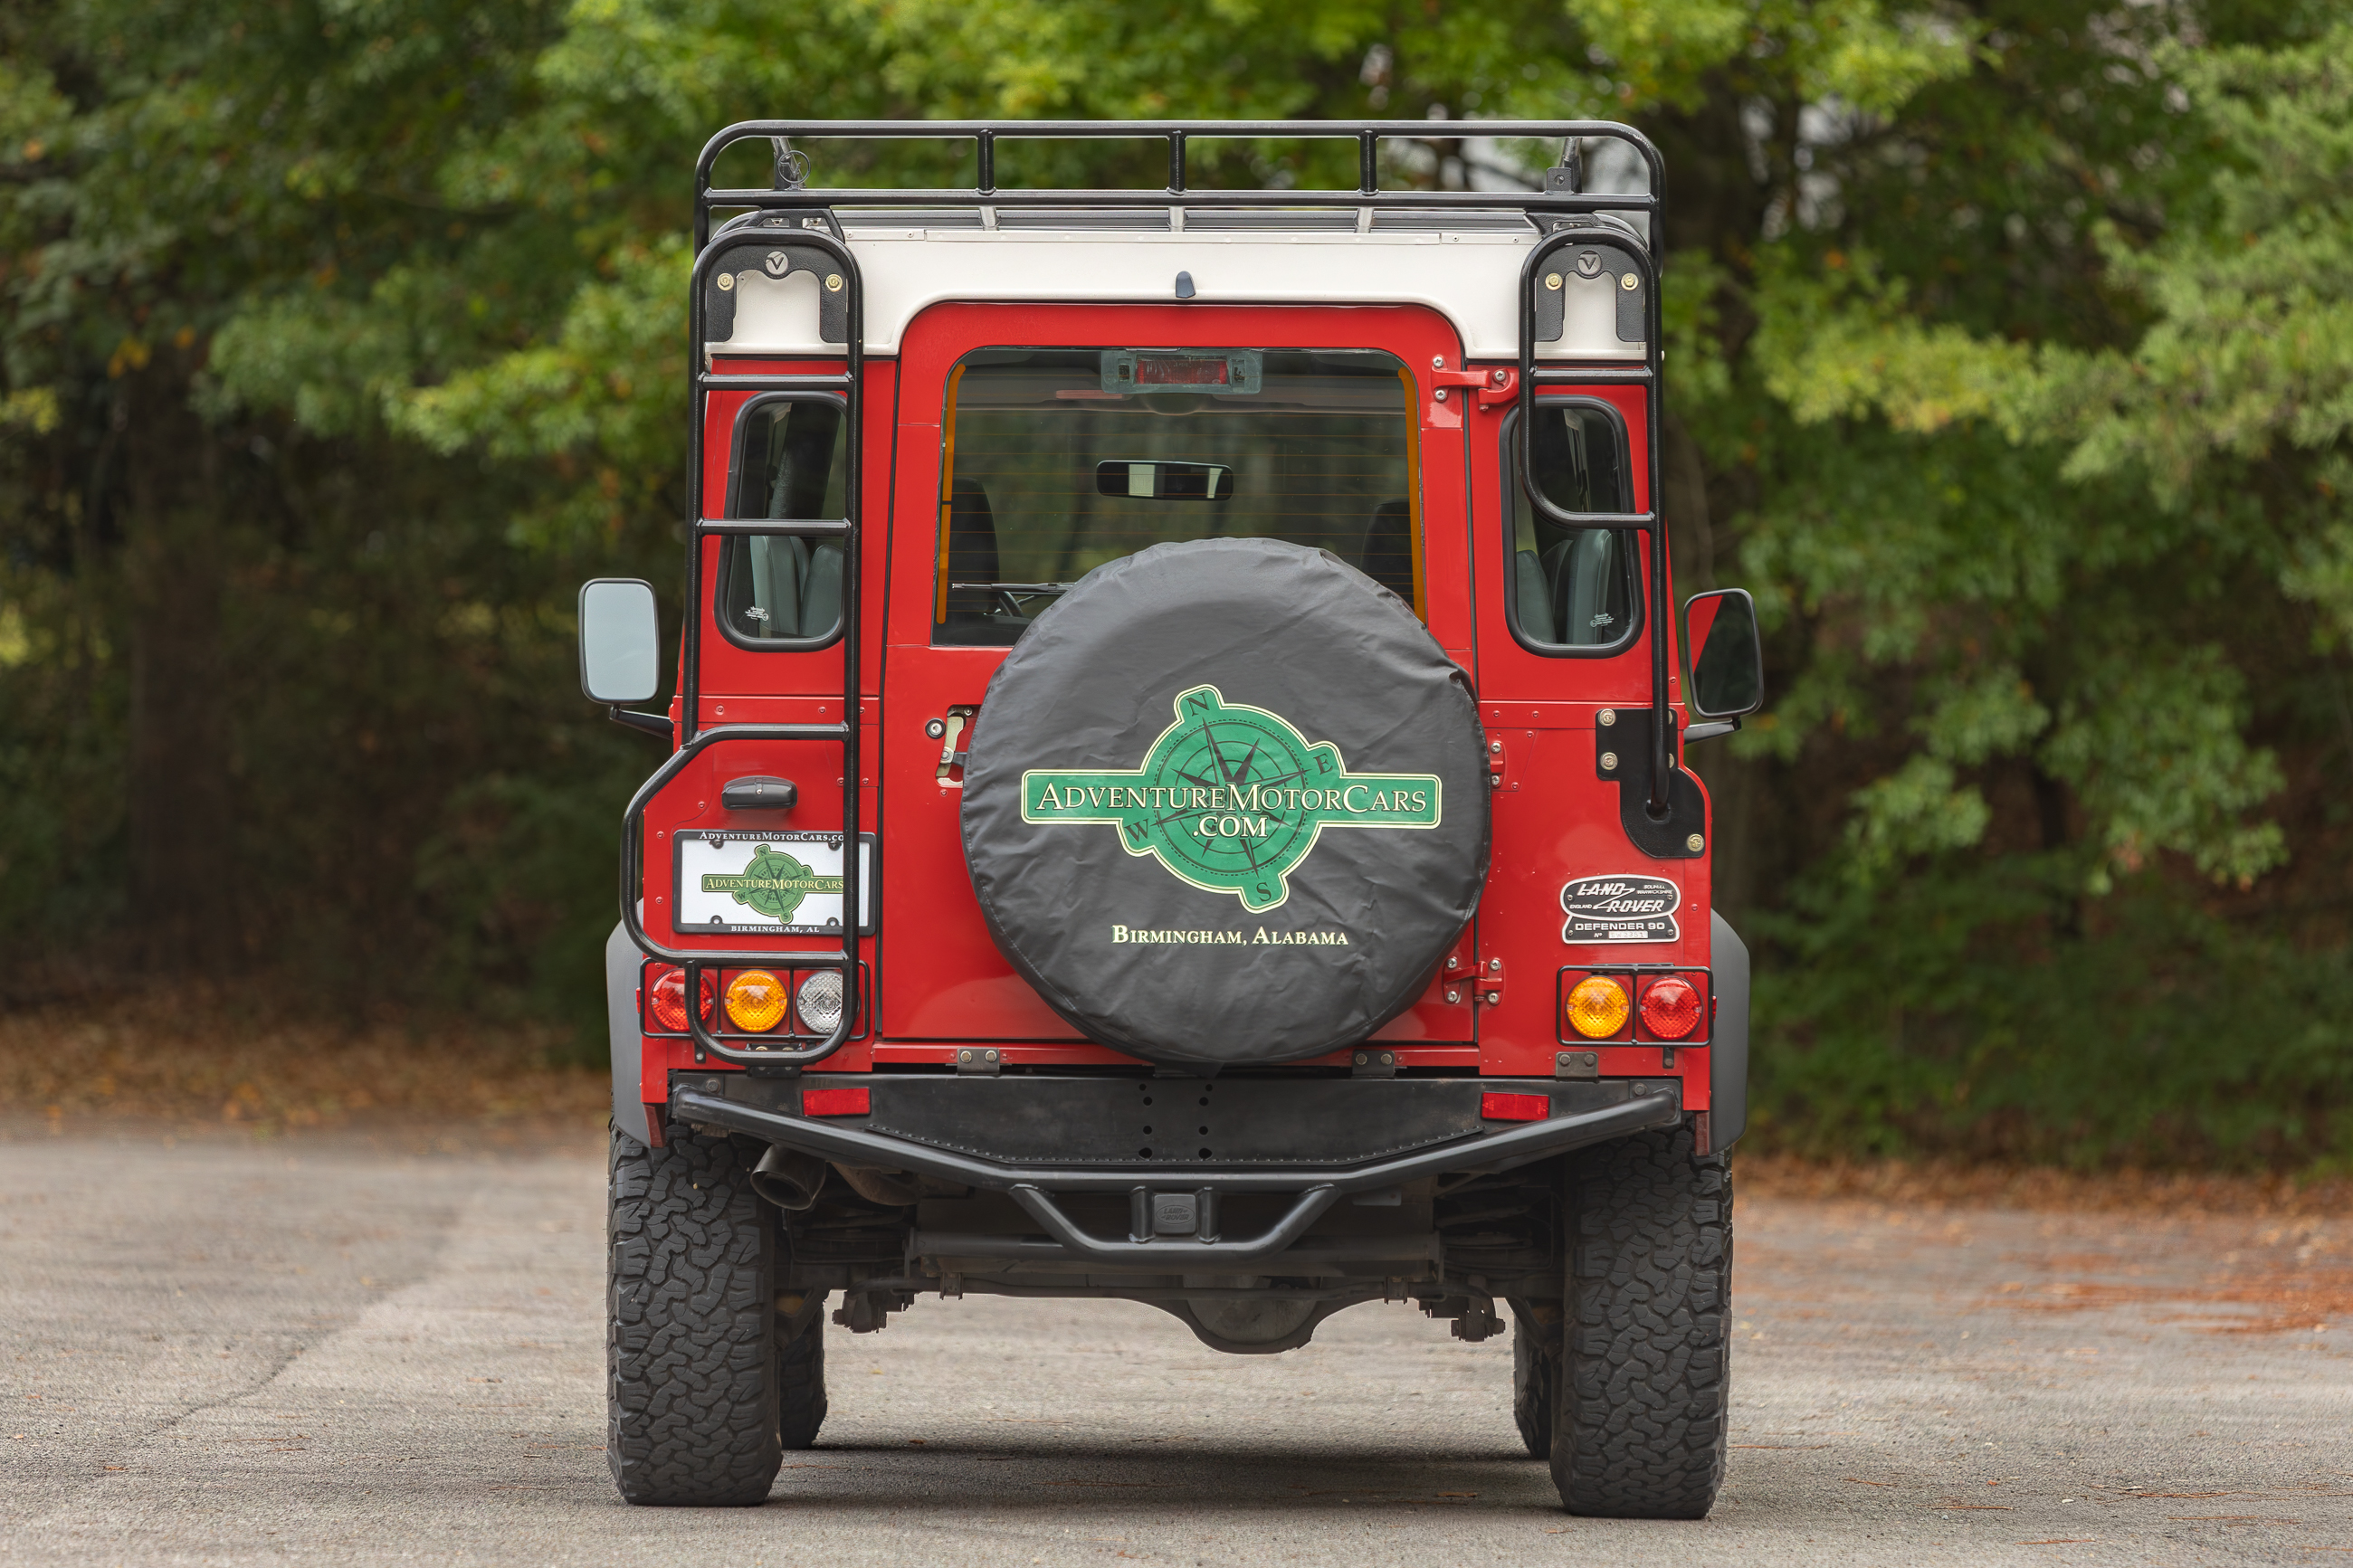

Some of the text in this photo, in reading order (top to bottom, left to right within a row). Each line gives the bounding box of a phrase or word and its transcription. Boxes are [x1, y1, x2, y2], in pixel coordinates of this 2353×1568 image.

[1186, 692, 1210, 717] N
[1313, 753, 1334, 775] E
[1125, 819, 1149, 842] W
[758, 848, 767, 857] N
[738, 891, 747, 900] W
[1255, 881, 1272, 902] S
[1577, 882, 1627, 896] LAND
[1606, 899, 1665, 913] ROVER
[783, 912, 788, 920] S
[730, 926, 804, 934] BIRMINGHAM,
[1575, 922, 1665, 931] DEFENDER 90
[1111, 925, 1348, 946] BIRMINGHAM, ALABAMA
